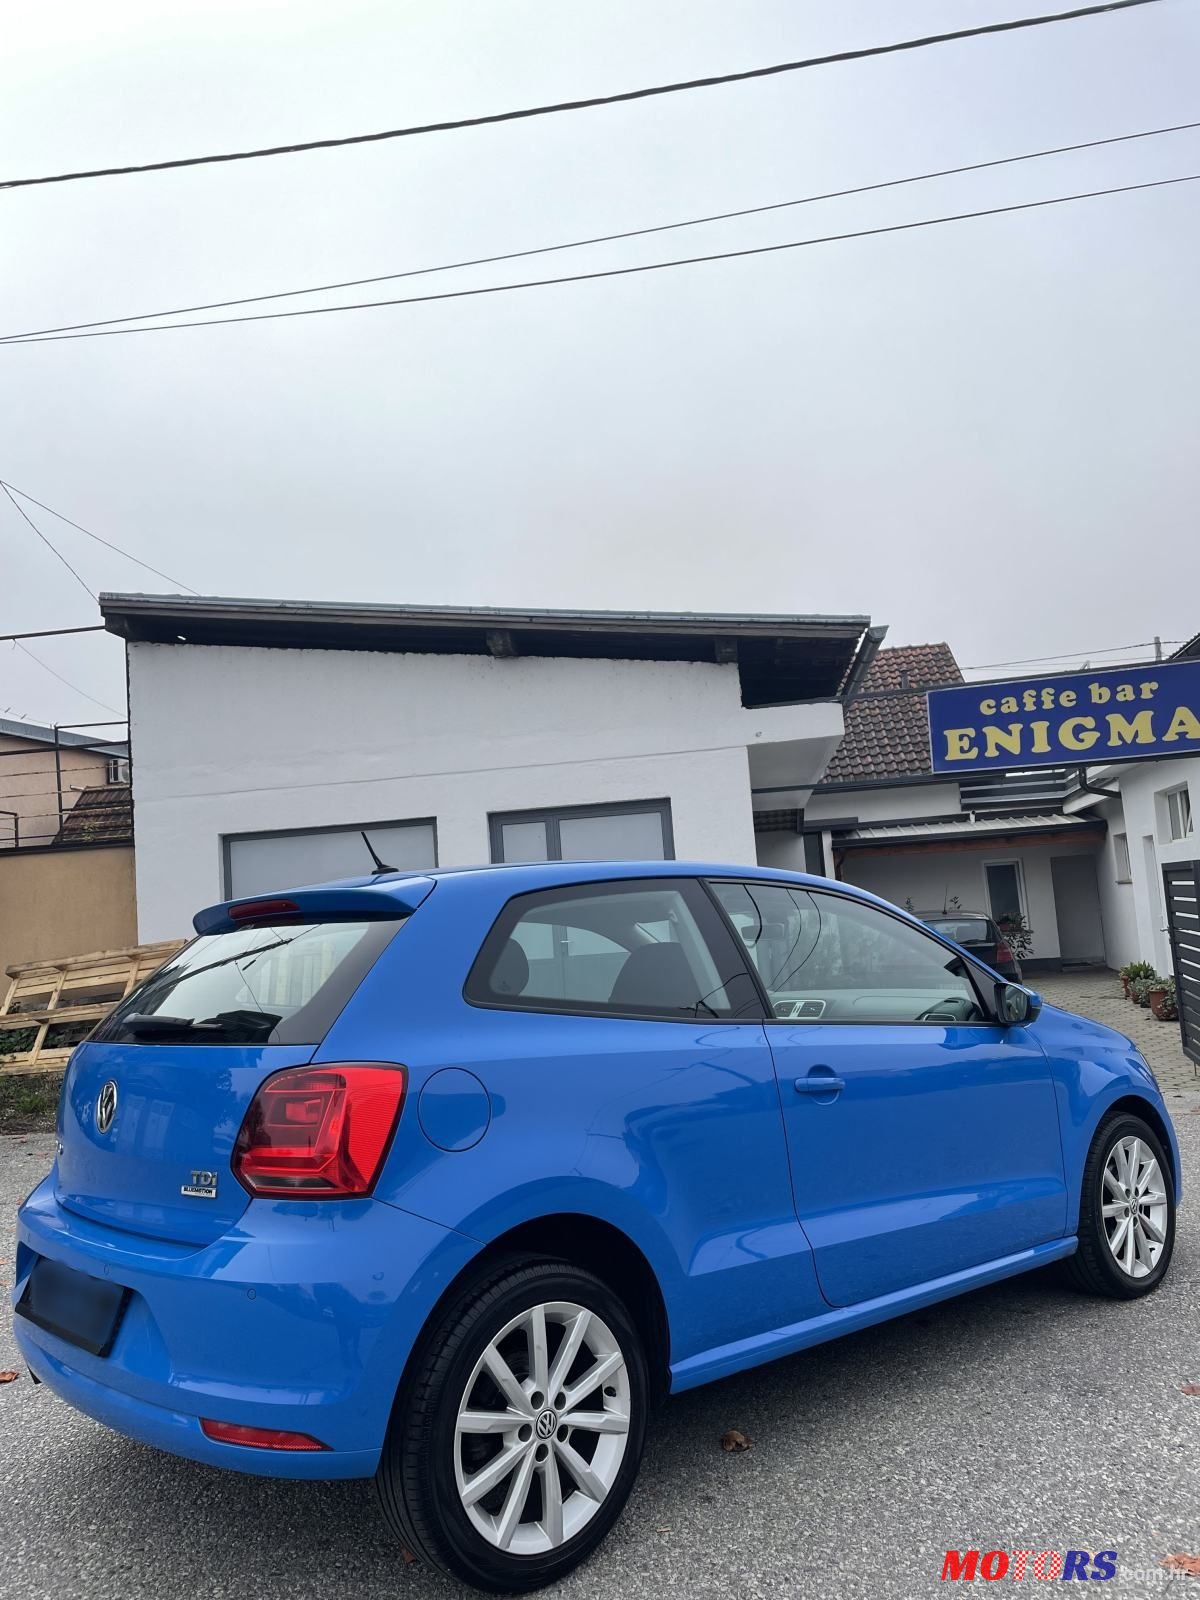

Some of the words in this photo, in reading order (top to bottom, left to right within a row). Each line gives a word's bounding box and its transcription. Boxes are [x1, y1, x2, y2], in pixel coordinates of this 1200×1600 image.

[979, 688, 1077, 716] caffe
[1088, 681, 1159, 704] bar
[944, 706, 1200, 761] ENIGMA
